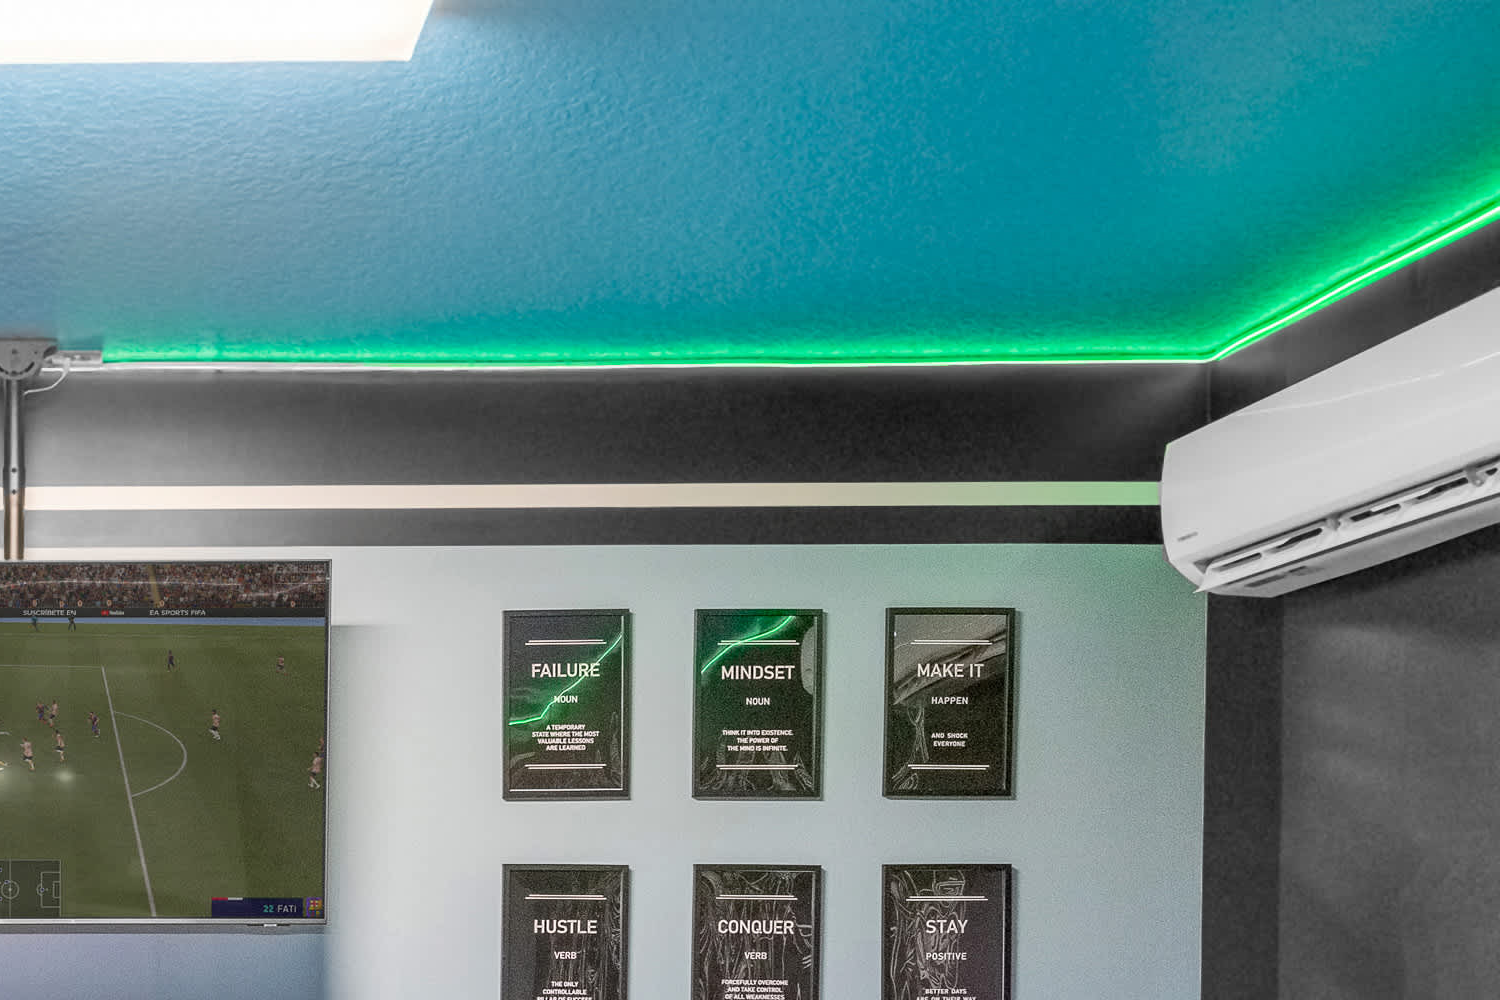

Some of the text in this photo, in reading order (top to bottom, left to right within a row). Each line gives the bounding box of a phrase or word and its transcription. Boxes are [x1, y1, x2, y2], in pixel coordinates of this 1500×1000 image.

[531, 663, 600, 677] FAILURE
[721, 665, 795, 679] MINDSET
[917, 664, 984, 677] MAKE IT
[533, 920, 598, 934] HUSTLE
[718, 920, 794, 934] CONQUER
[926, 920, 968, 933] STAY
